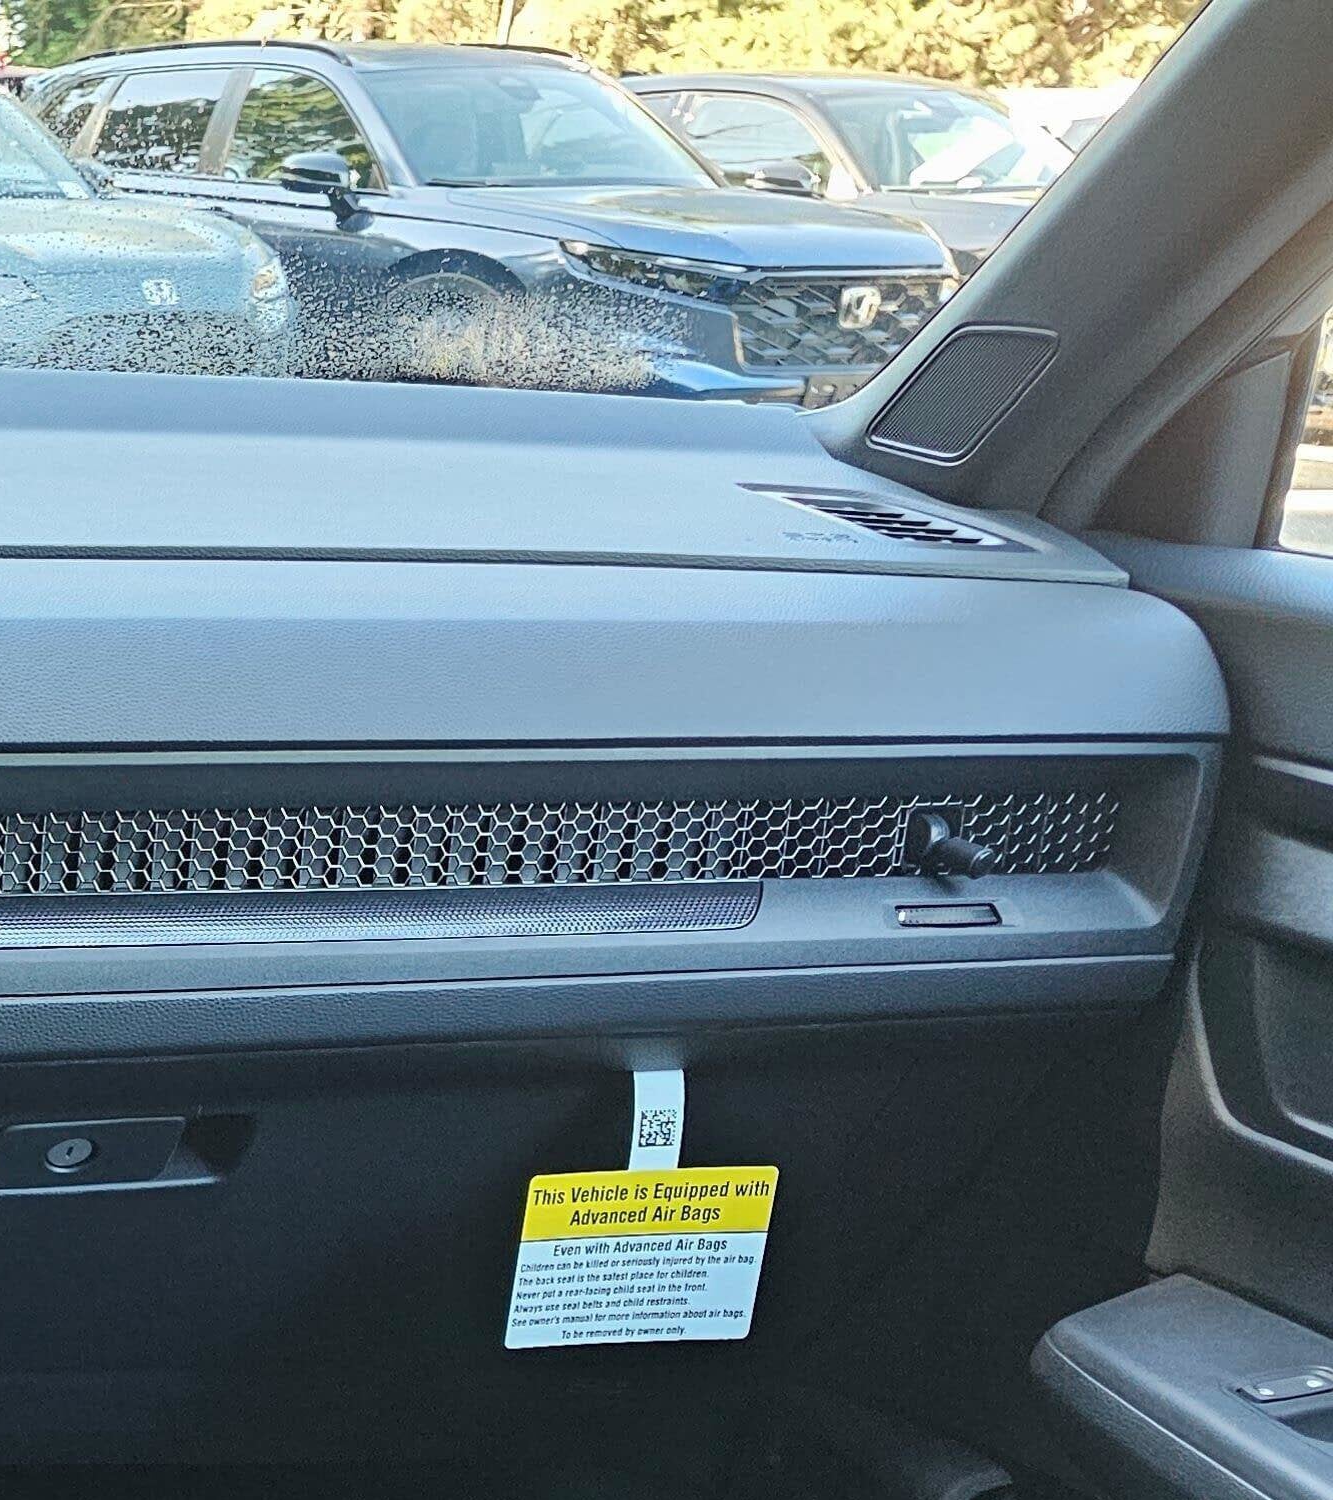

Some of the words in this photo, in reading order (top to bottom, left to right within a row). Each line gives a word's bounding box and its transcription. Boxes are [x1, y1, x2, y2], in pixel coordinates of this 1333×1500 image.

[533, 1189, 565, 1206] This
[571, 1185, 628, 1203] Vehicle
[634, 1183, 648, 1200] is
[653, 1181, 728, 1204] Equipped
[735, 1180, 770, 1197] with
[570, 1207, 648, 1226] Advanced
[652, 1206, 676, 1222] Air
[681, 1205, 721, 1224] Bags
[553, 1244, 581, 1257] Even
[585, 1242, 610, 1255] with
[613, 1239, 672, 1254] Advanced
[676, 1238, 694, 1251] Air
[697, 1238, 727, 1252] Bags
[520, 1263, 554, 1273] Children
[557, 1263, 571, 1271] can
[573, 1261, 583, 1269] be
[586, 1259, 609, 1268] killed
[622, 1257, 660, 1268] seriously
[662, 1256, 693, 1267] injured
[695, 1256, 706, 1266] by
[707, 1255, 721, 1264] the
[723, 1255, 736, 1264] air
[738, 1254, 757, 1265] bag.
[519, 1277, 533, 1286] The
[535, 1276, 554, 1285] back
[557, 1275, 575, 1284] seat
[577, 1274, 584, 1283] is
[587, 1273, 600, 1282] the
[602, 1272, 628, 1281] safest
[630, 1270, 654, 1282] place
[656, 1270, 669, 1280] for
[670, 1269, 709, 1279] children.
[516, 1291, 540, 1300] Never
[542, 1289, 555, 1300] put
[565, 1287, 611, 1297] rear-facing
[613, 1285, 635, 1294] child
[637, 1284, 655, 1293] seat
[657, 1283, 666, 1292] in
[668, 1283, 682, 1292] the
[513, 1304, 542, 1314] Always
[582, 1300, 603, 1309] belts
[605, 1299, 621, 1308] and
[623, 1297, 644, 1307] child
[511, 1318, 527, 1327] See
[529, 1316, 560, 1327] owner's
[562, 1313, 593, 1324] manual
[594, 1313, 606, 1322] for
[607, 1313, 630, 1321] more
[632, 1310, 681, 1320] information
[682, 1309, 707, 1319] about
[708, 1309, 721, 1318] air
[723, 1308, 747, 1319] bags.
[561, 1330, 571, 1339] To
[573, 1330, 584, 1338] be
[585, 1328, 623, 1338] removed
[624, 1327, 635, 1337] by
[637, 1327, 664, 1335] owner
[666, 1325, 687, 1336] only.
